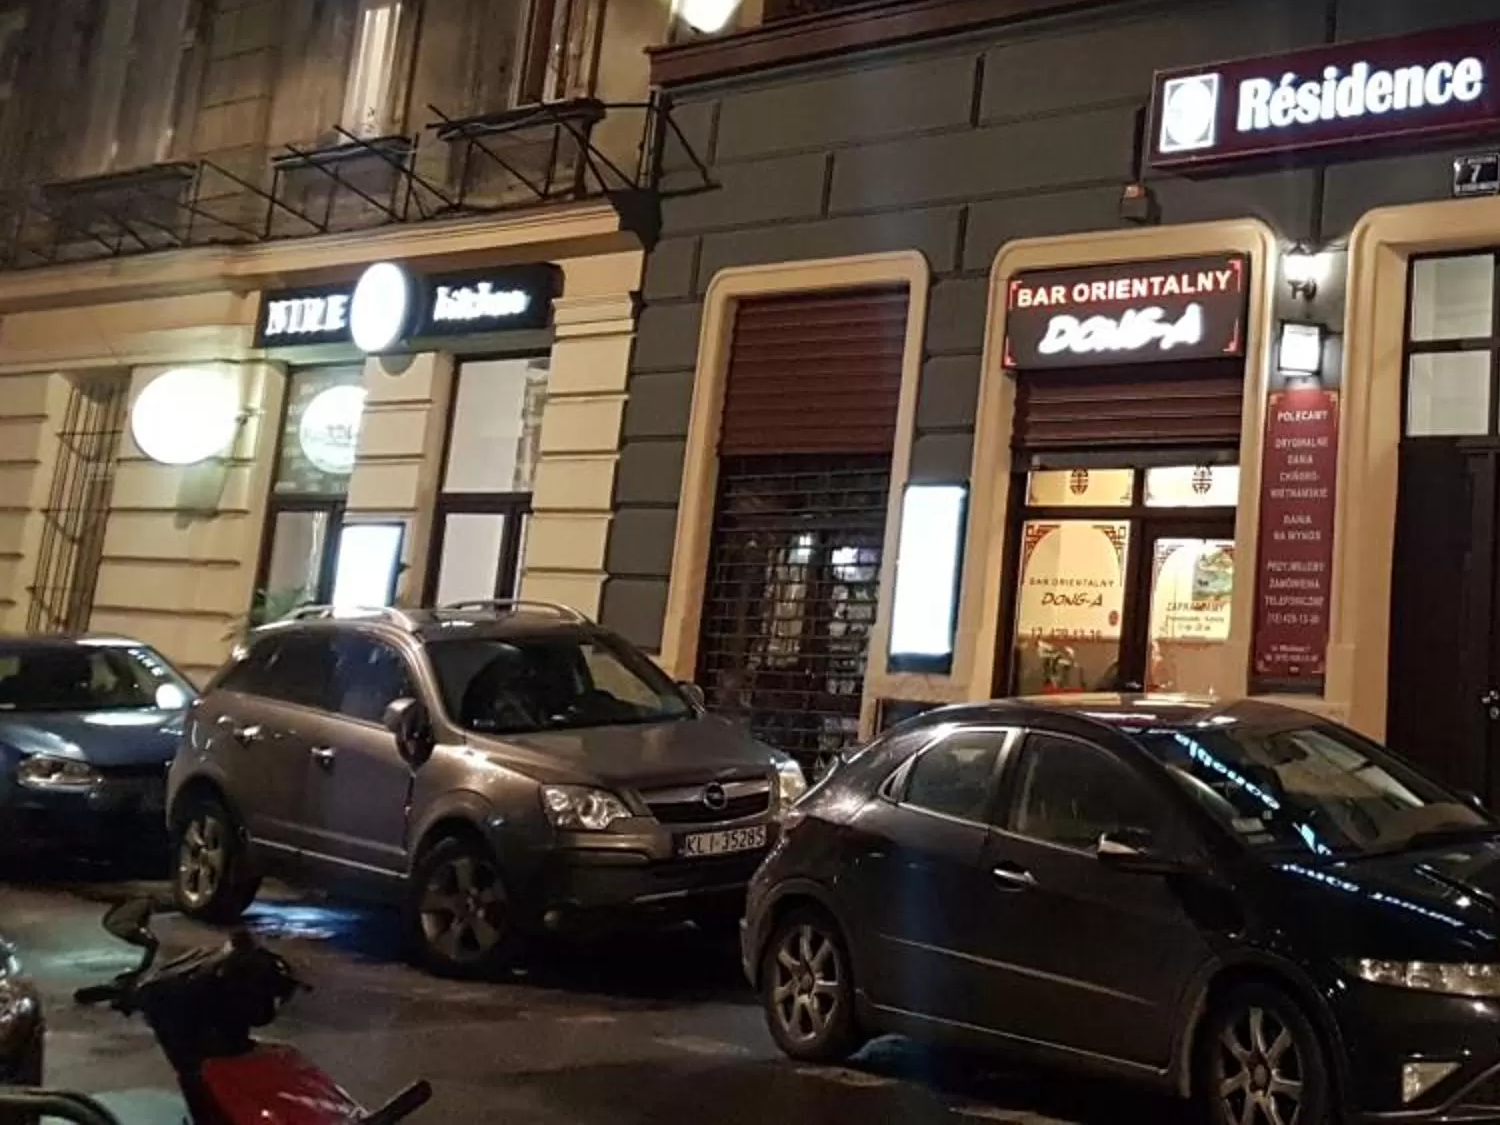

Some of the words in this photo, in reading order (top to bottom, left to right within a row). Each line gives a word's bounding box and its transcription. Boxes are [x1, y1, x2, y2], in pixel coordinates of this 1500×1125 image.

[1237, 54, 1483, 133] Résidence
[1471, 164, 1482, 184] 7
[1016, 286, 1067, 307] BAR
[1071, 270, 1232, 302] ORIENTALNY
[1037, 302, 1203, 355] DONG-A
[1041, 592, 1104, 607] DONG-A
